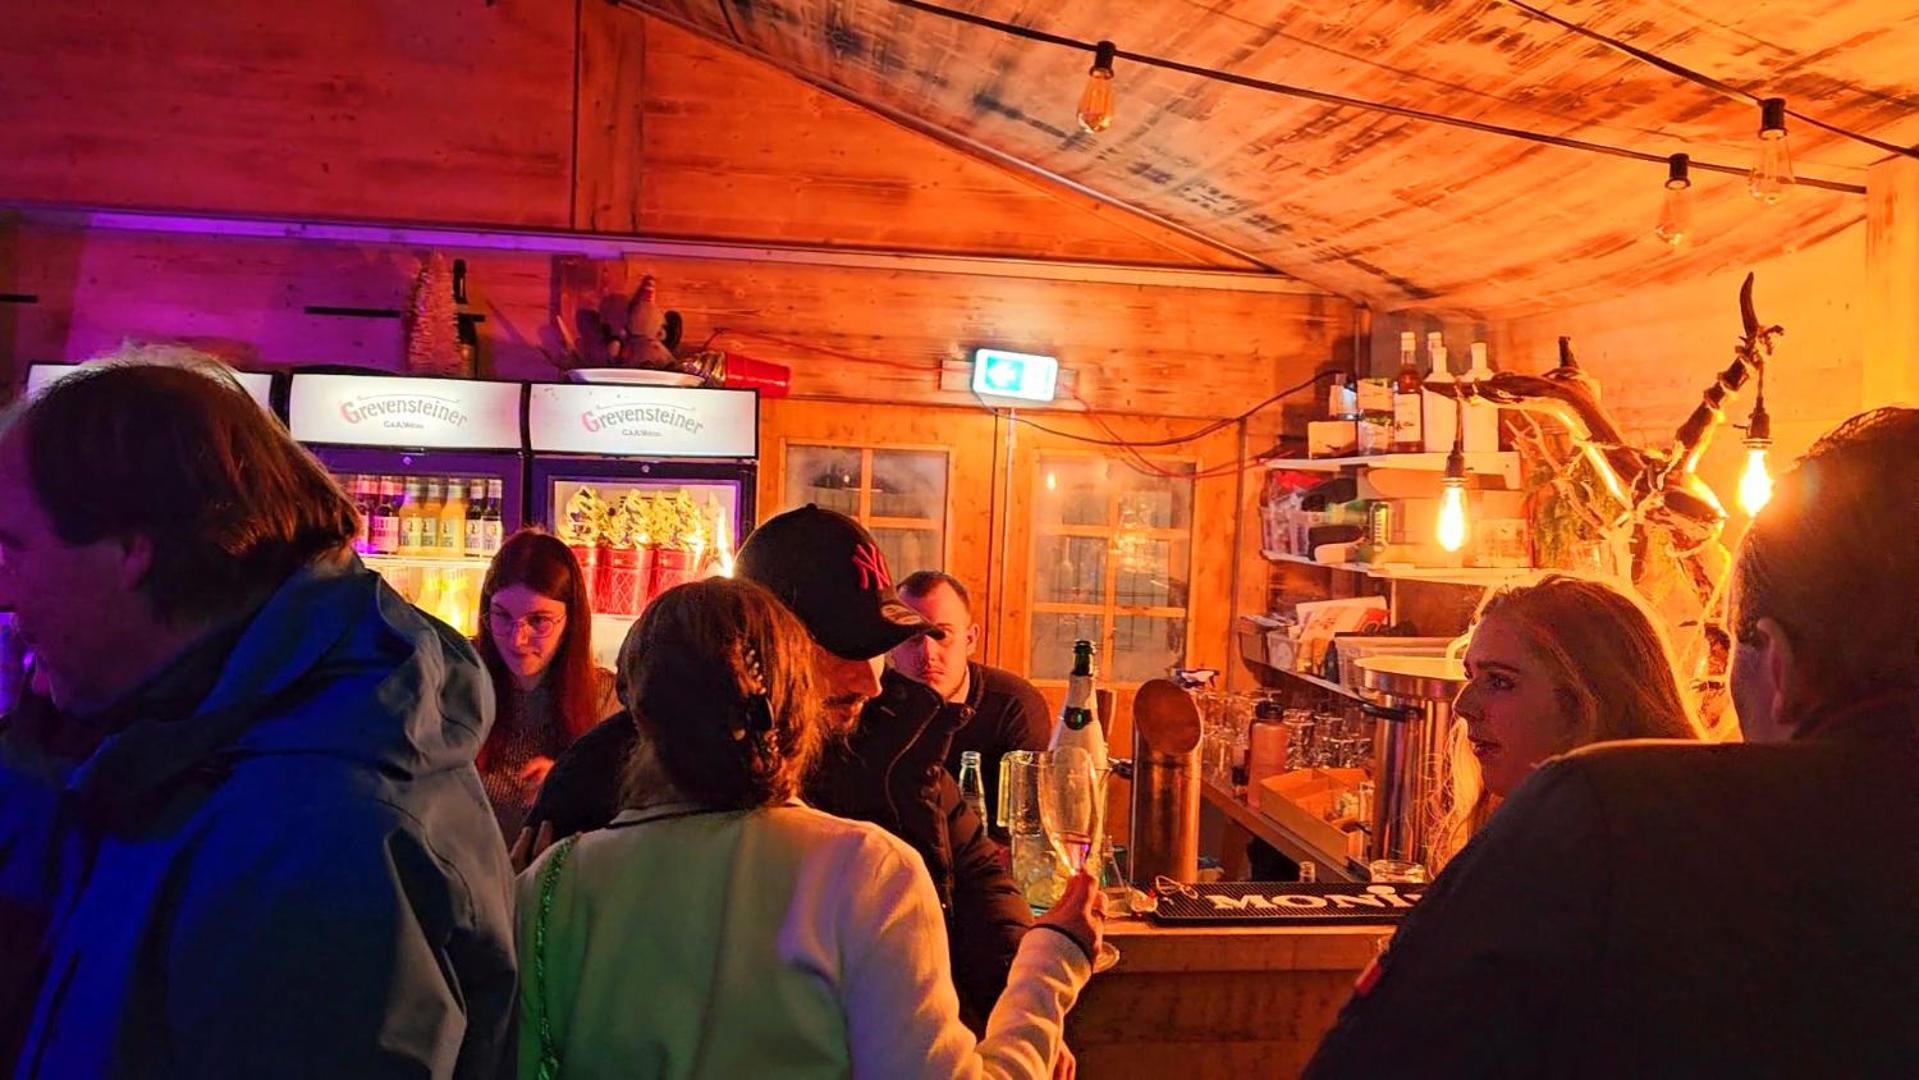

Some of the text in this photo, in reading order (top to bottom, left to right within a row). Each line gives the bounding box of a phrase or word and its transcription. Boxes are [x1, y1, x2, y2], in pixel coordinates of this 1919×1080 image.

[340, 399, 468, 427] Grevensteiner
[581, 407, 704, 434] Grevensteiner
[853, 541, 891, 591] NY
[1205, 885, 1423, 909] MONI
